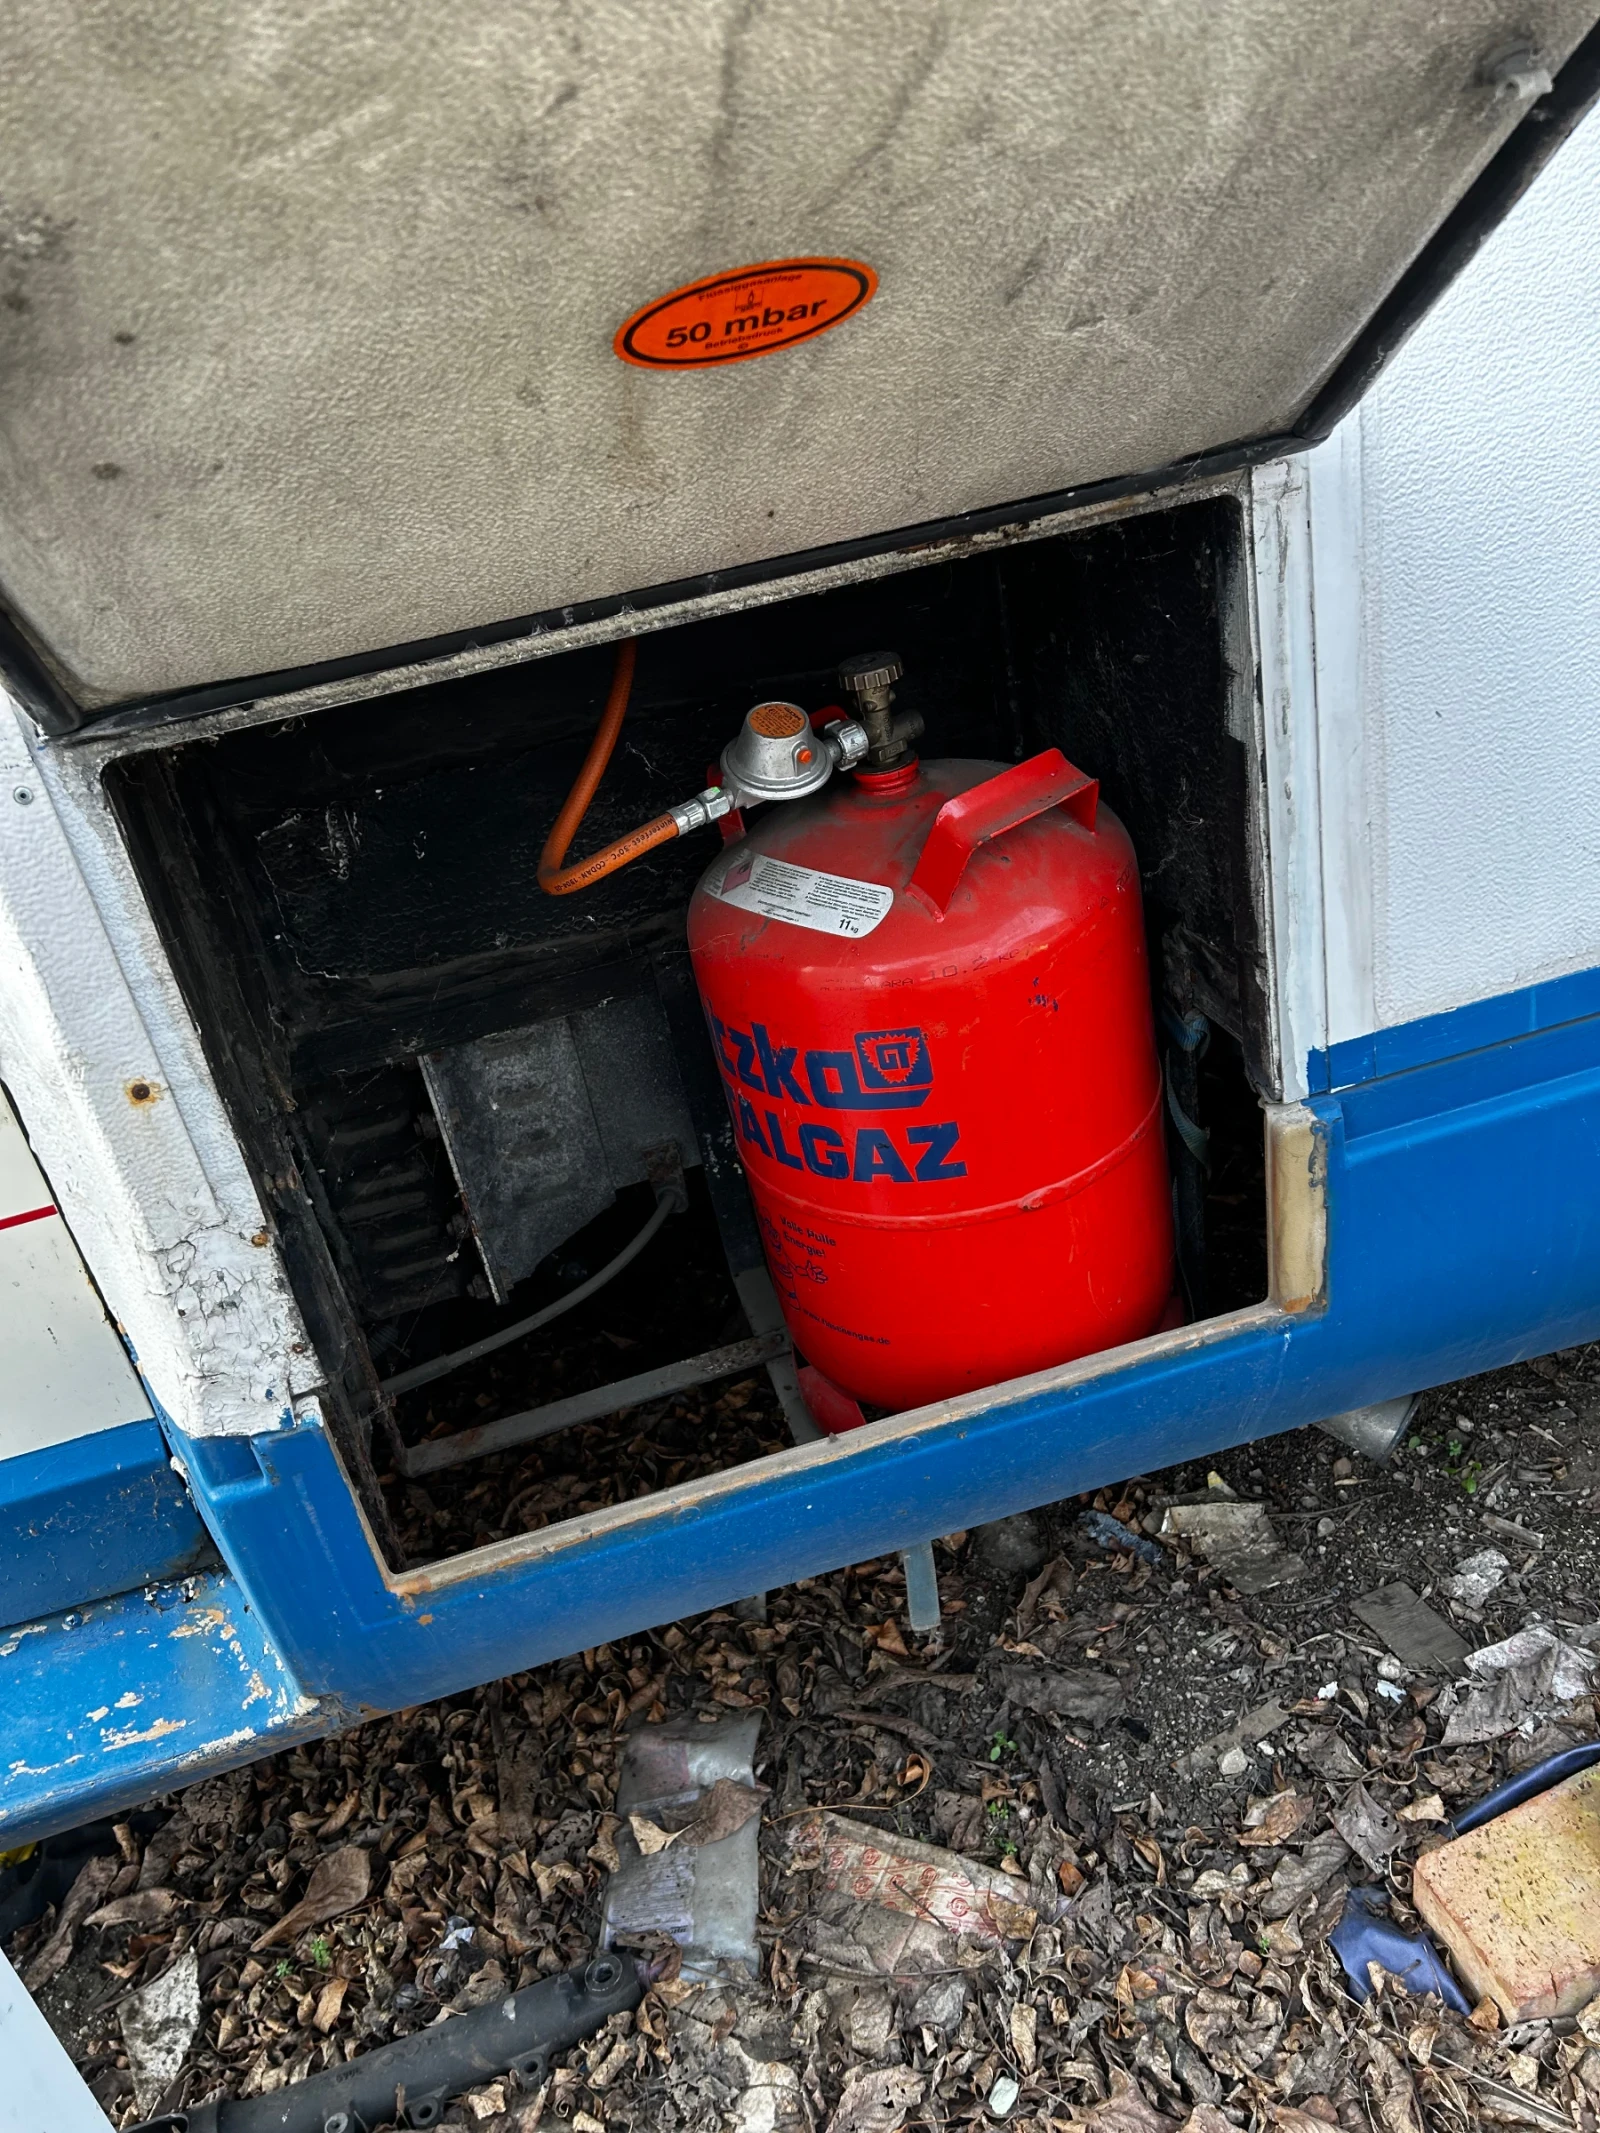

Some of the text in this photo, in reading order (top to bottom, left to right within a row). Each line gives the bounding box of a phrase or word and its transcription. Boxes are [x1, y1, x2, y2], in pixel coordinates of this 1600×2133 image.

[665, 321, 712, 348] 50
[723, 299, 828, 337] mbar
[581, 860, 606, 879] CODAN
[839, 918, 852, 930] 11
[927, 954, 988, 981] 10.2
